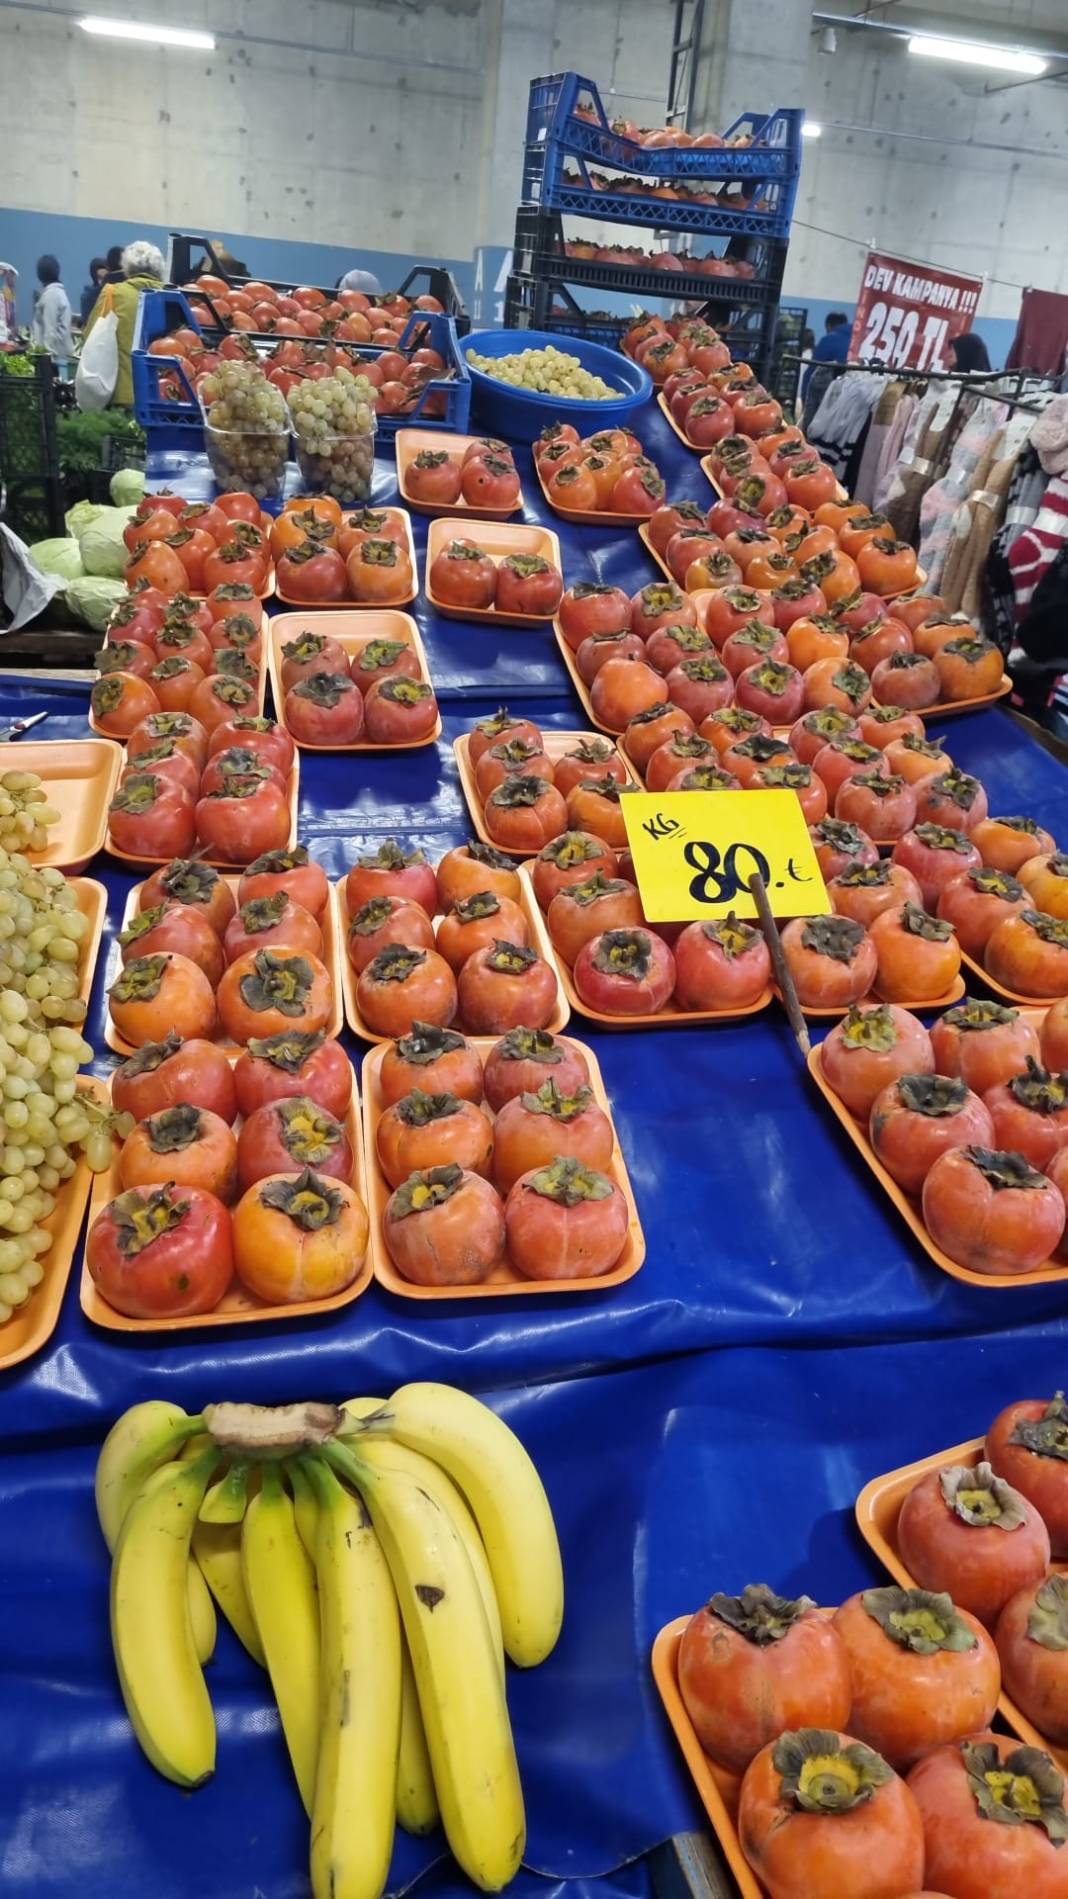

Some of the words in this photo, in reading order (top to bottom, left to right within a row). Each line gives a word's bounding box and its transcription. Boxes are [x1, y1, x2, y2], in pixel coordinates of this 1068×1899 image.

[864, 265, 895, 292] DEV
[892, 273, 959, 310] KAMPANYA
[958, 290, 978, 314] !!!
[858, 302, 919, 369] 250
[917, 316, 949, 371] TL
[642, 813, 680, 840] KG
